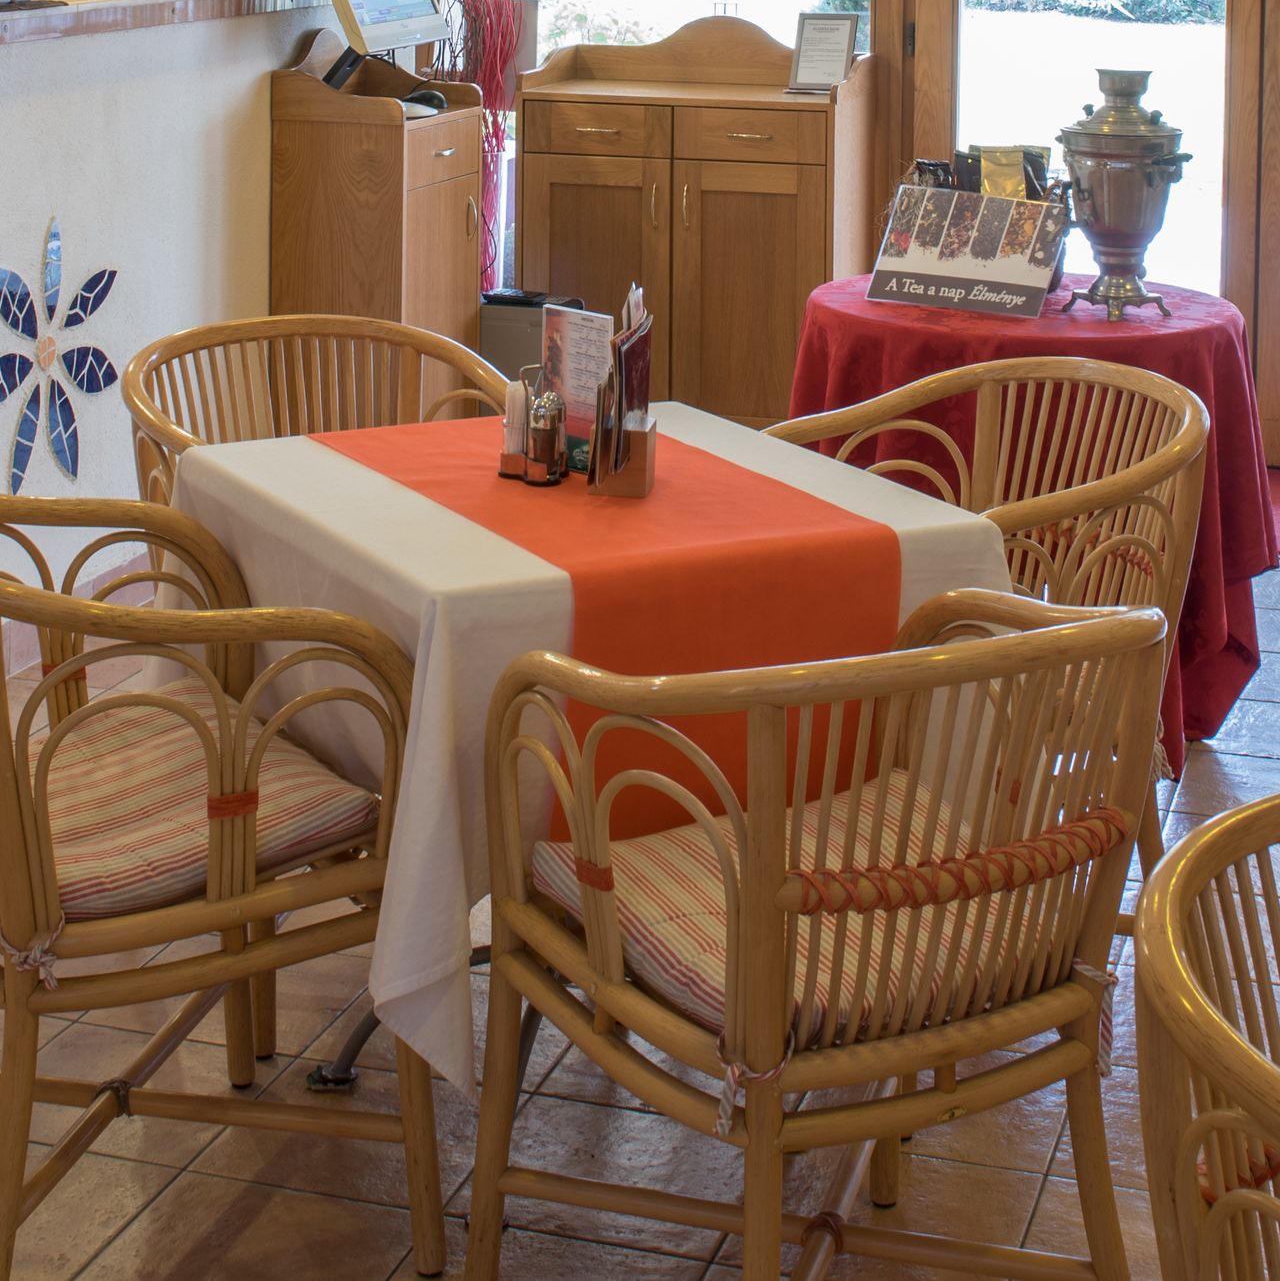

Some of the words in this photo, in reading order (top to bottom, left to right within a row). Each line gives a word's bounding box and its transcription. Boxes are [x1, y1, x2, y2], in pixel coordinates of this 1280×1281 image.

[885, 278, 898, 291] A
[902, 278, 924, 295] Tea
[927, 285, 936, 296] a
[939, 287, 966, 302] nap
[968, 284, 1027, 308] Élménye
